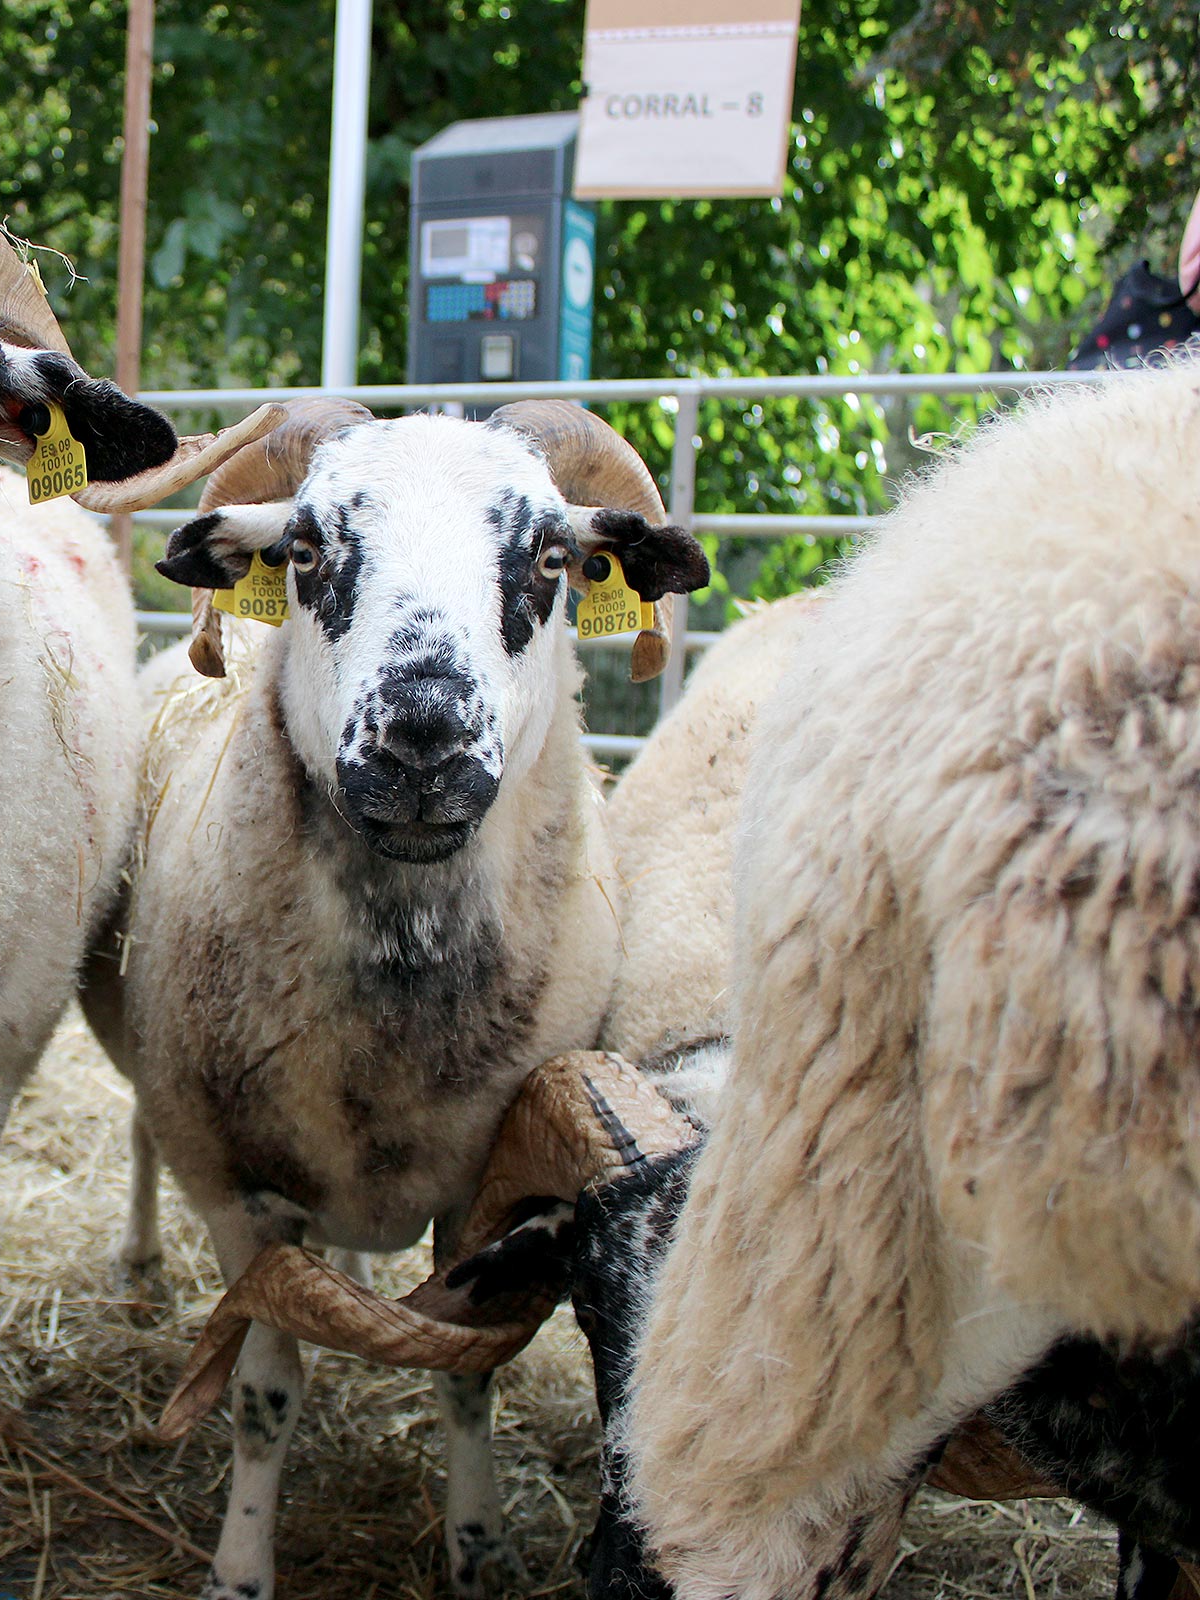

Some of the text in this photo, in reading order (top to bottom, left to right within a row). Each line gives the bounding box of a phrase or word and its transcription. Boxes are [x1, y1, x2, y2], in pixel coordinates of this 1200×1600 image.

[605, 92, 714, 120] CORRAL
[747, 91, 764, 118] 8
[41, 438, 71, 459] ES 09
[41, 452, 74, 473] 10010
[31, 464, 84, 500] 09065
[252, 575, 270, 586] ES
[592, 591, 609, 604] ES
[592, 600, 626, 615] 10009
[581, 610, 638, 636] 90878
